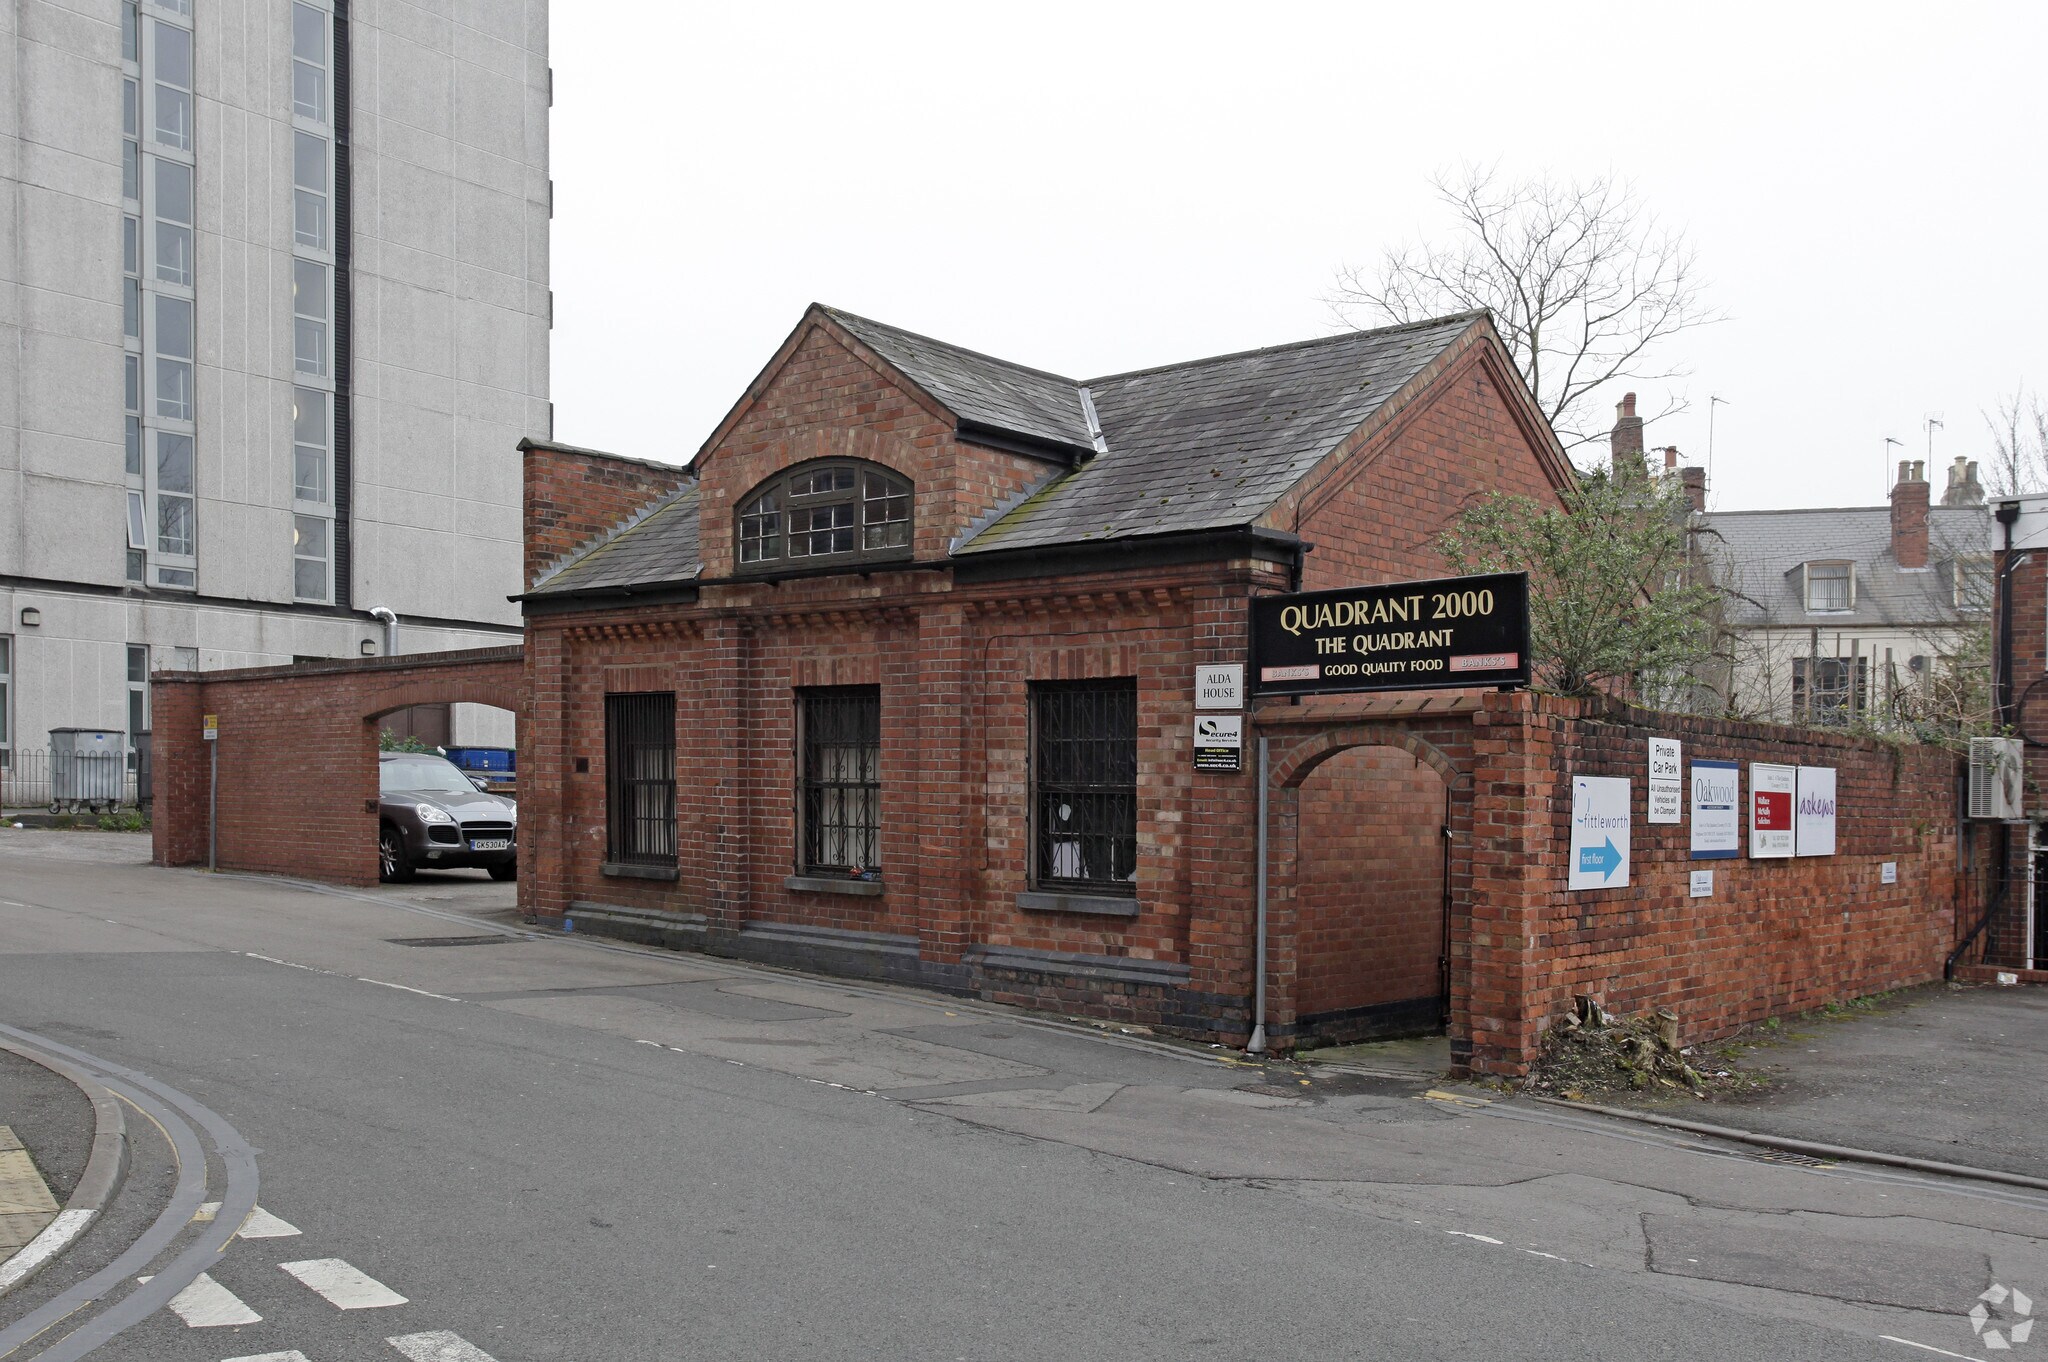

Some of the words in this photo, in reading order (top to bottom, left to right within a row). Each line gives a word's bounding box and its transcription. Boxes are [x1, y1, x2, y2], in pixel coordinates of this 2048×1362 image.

[1280, 595, 1425, 636] QUADRANT
[1431, 589, 1494, 619] 2000
[1315, 637, 1347, 654] THE
[1353, 629, 1454, 656] QUADRANT
[1324, 664, 1358, 676] GOOD
[1361, 661, 1407, 676] QUALITY
[1411, 659, 1444, 672] FOOD
[1461, 656, 1506, 668] BANKS'S
[1207, 673, 1231, 684] ALDA
[1203, 688, 1235, 698] HOUSE
[1656, 744, 1675, 758] Private
[1653, 761, 1664, 774] Car
[1665, 762, 1678, 775] Park
[1657, 785, 1680, 794] Unauthorised
[1695, 778, 1735, 803] Oakwood
[1654, 795, 1670, 804] Vehicles
[1800, 792, 1835, 818] askews
[1654, 807, 1660, 815] be
[1660, 807, 1676, 816] Clamped
[1584, 813, 1629, 829] fittleworth
[1581, 853, 1592, 865] first
[1592, 853, 1605, 865] floor
